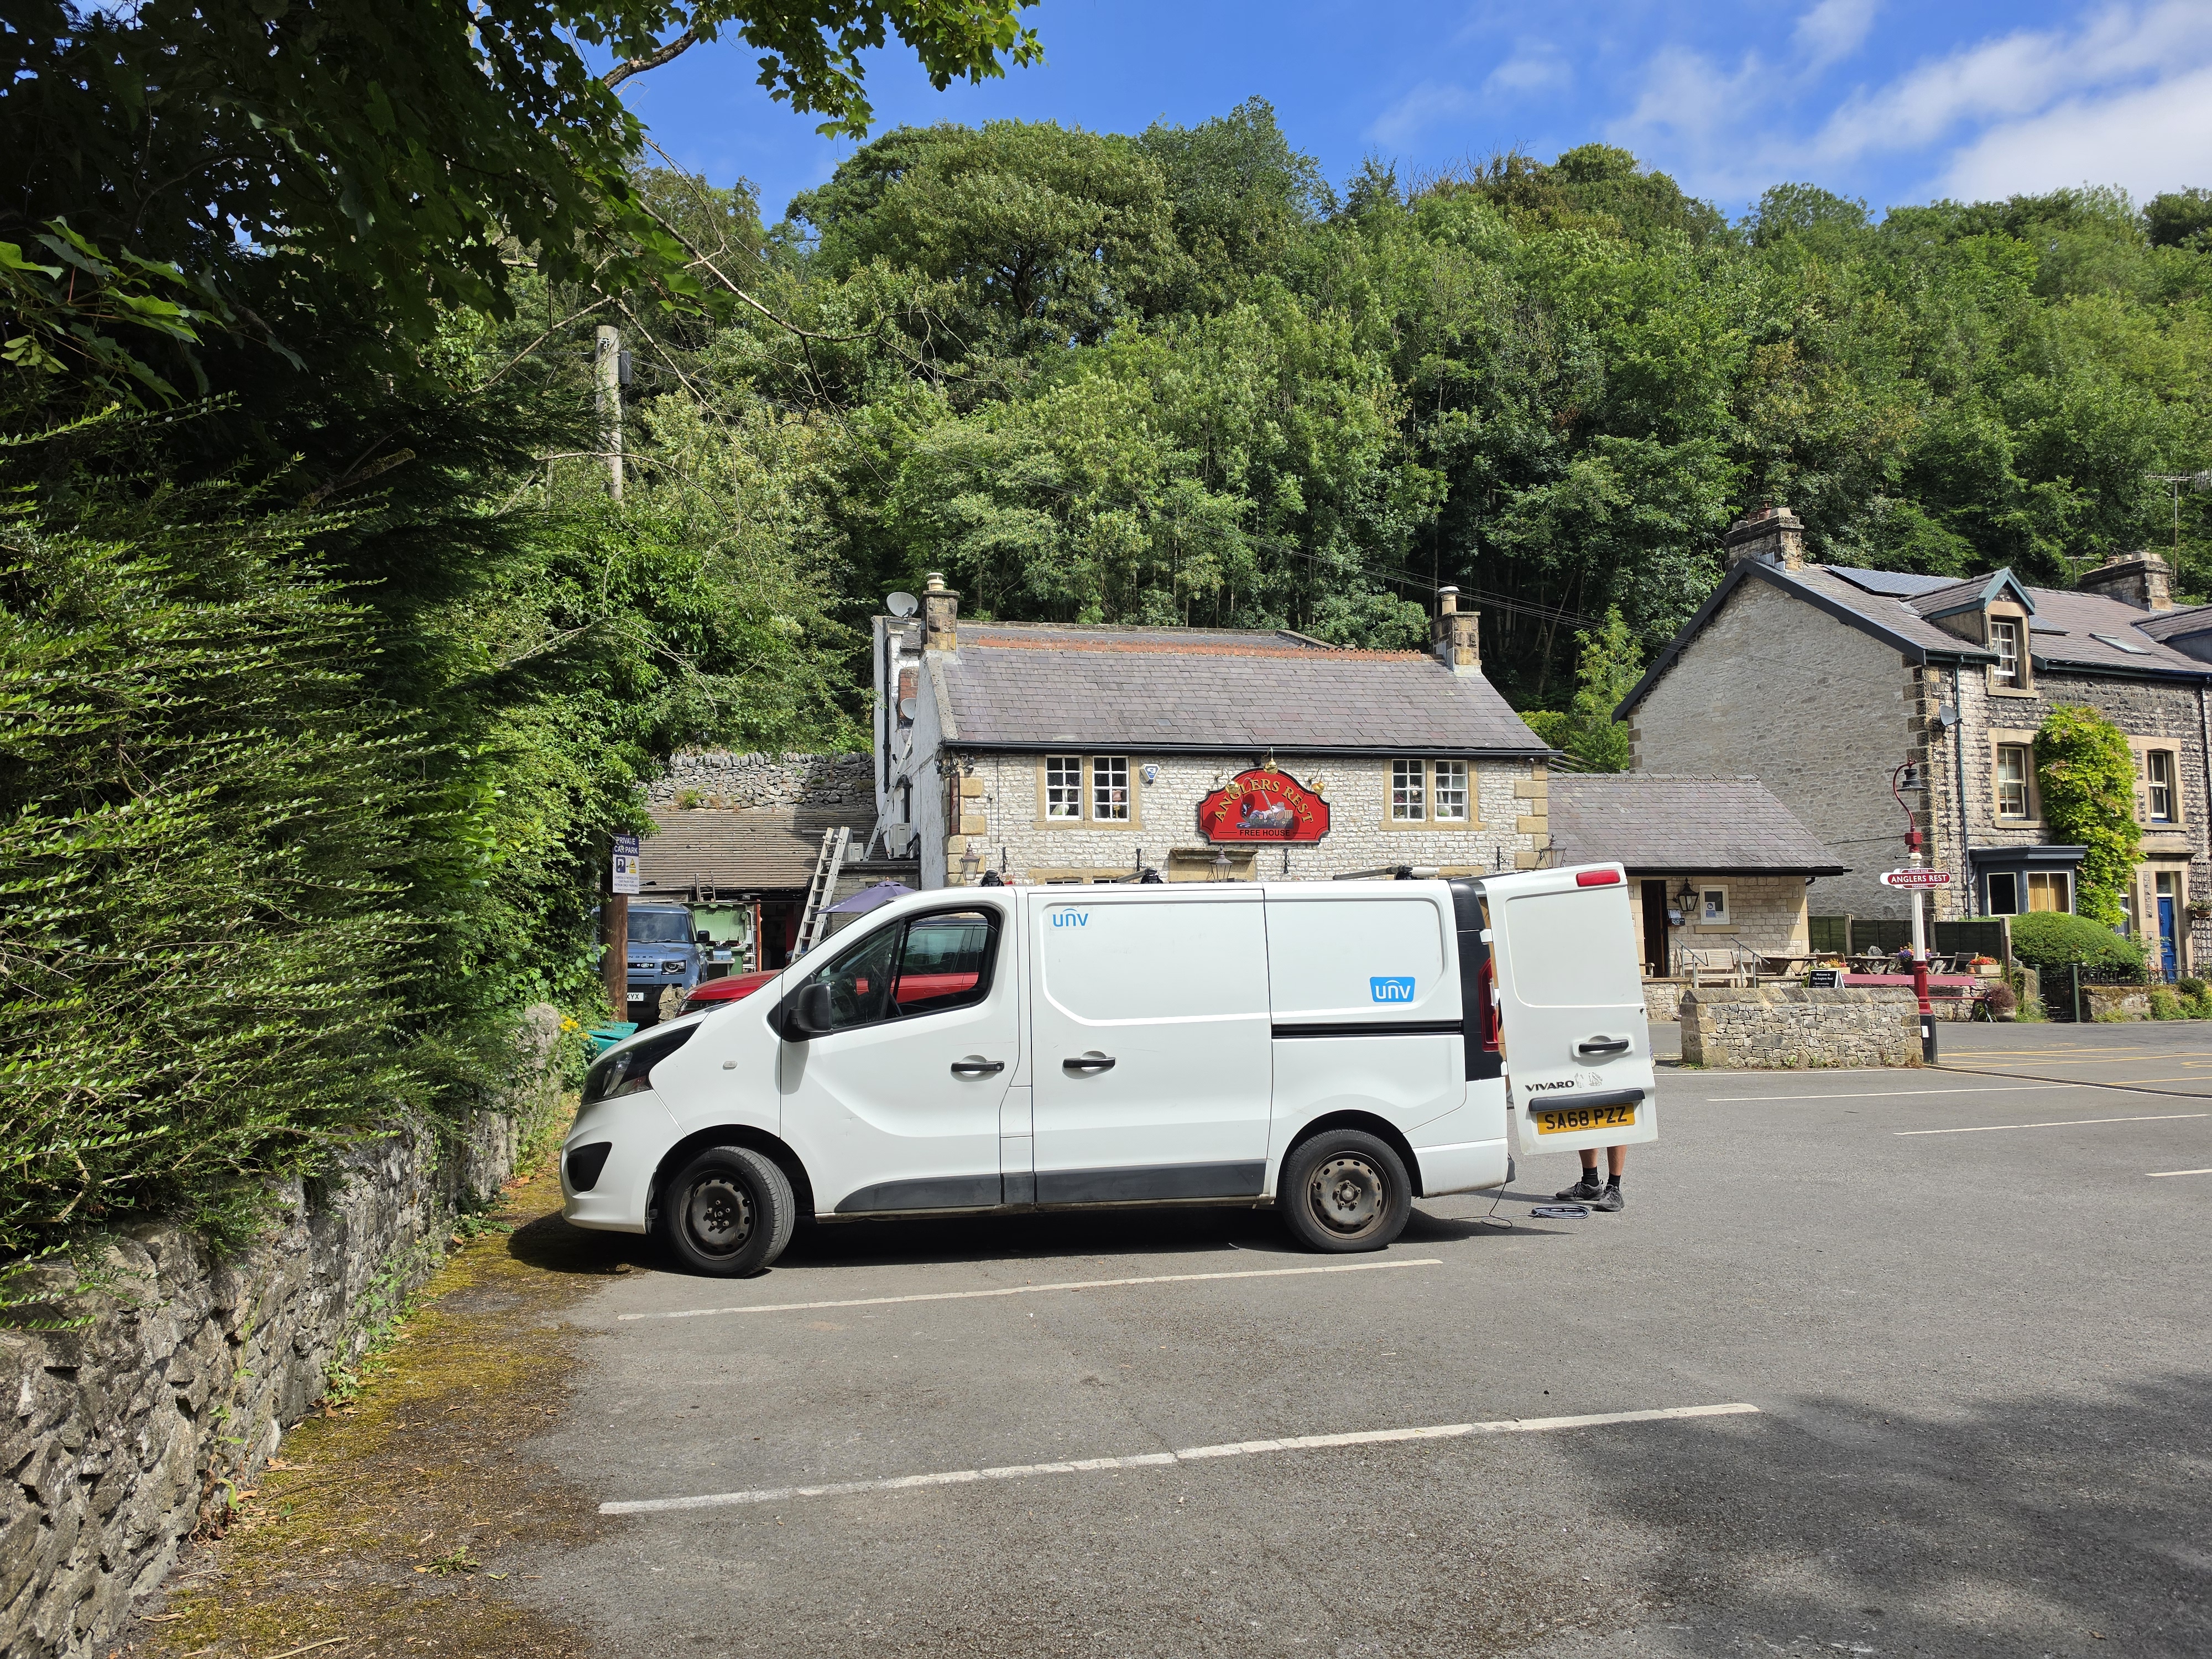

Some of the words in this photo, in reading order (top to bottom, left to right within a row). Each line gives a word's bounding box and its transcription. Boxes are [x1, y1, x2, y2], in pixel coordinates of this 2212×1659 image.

[1214, 779, 1280, 823] ANGLERS
[1281, 786, 1314, 824] REST
[1891, 875, 1927, 883] ANGLERS
[1525, 1080, 1574, 1092] VIVARO
[1545, 1110, 1589, 1130] SA68
[1594, 1107, 1627, 1125] PZZ
